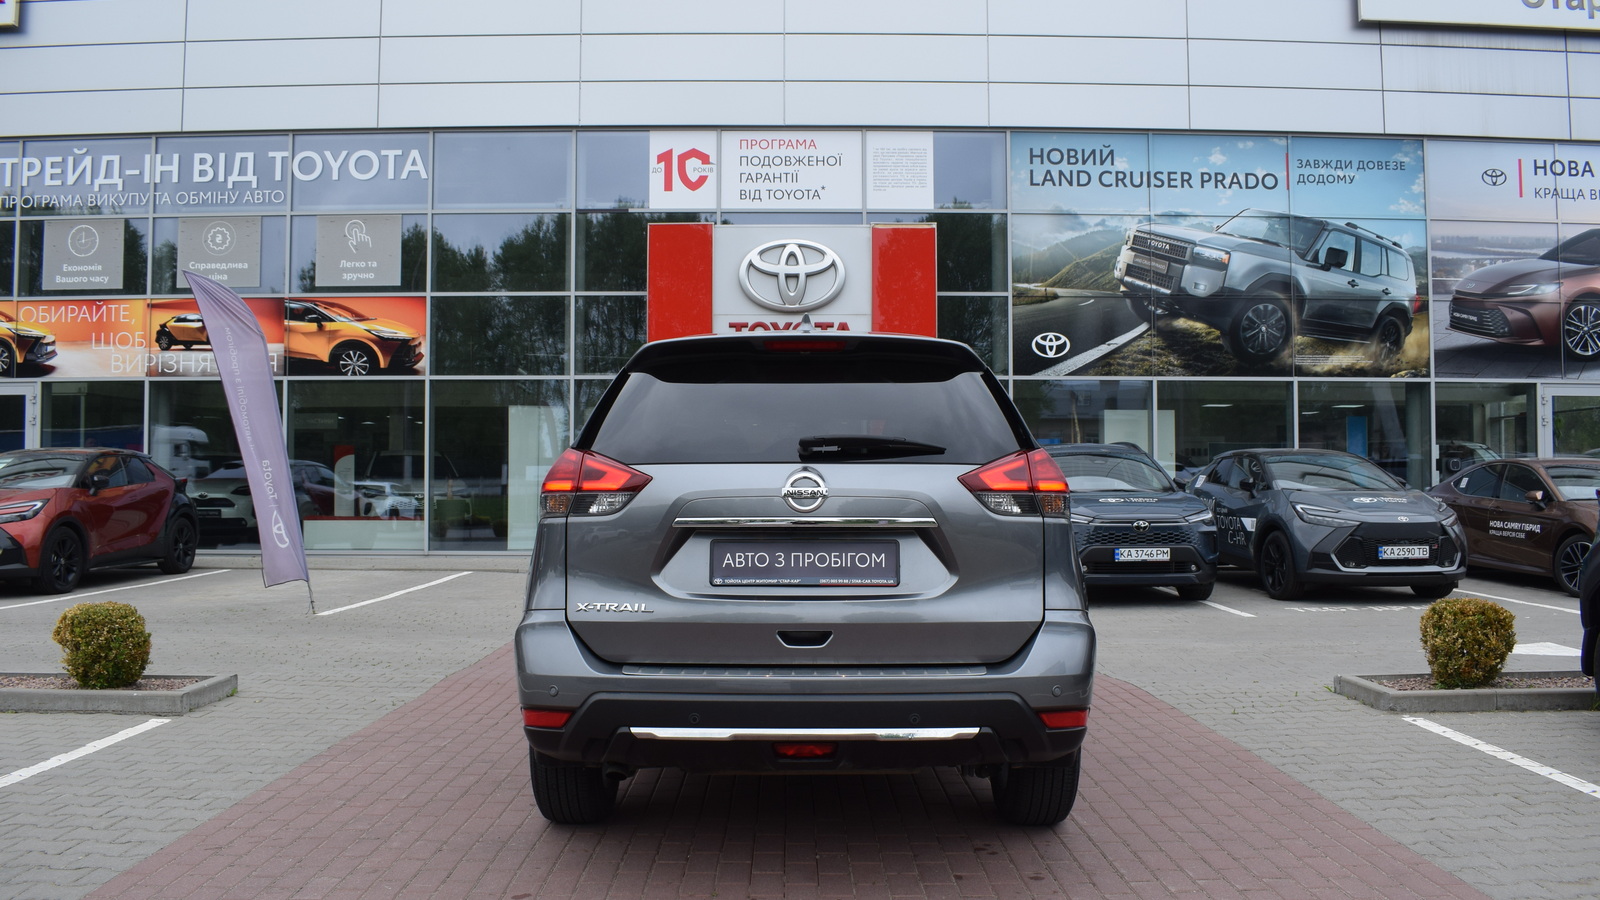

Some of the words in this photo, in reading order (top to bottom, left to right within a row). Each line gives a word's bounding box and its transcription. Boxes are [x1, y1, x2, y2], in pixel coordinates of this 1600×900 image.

[739, 138, 817, 150] ПРОГРАМА
[739, 153, 842, 168] ПОДОВЖЕНОЇ
[1029, 144, 1115, 166] НОВИЙ
[0, 147, 180, 192] ТРЕЙД-ІН
[193, 151, 258, 189] ВІД
[268, 149, 429, 181] TOYOTA
[692, 166, 714, 174] РОКІВ
[1296, 158, 1353, 171] ЗАВЖДИ
[1356, 159, 1406, 171] ДОВЕЗЕ
[1533, 159, 1595, 178] НОВА
[739, 169, 799, 183] ГАРАНТІЇ
[1029, 169, 1092, 187] LAND
[1098, 170, 1194, 189] CRUISER
[1200, 171, 1279, 190] PRADO
[1296, 173, 1356, 186] ДОДОМУ
[0, 194, 83, 209] ПРОГРАМА
[88, 192, 150, 208] ВИКУПУ
[154, 192, 171, 206] ТА
[176, 190, 239, 206] ОБМІНУ
[242, 189, 285, 204] АВТО
[739, 188, 762, 202] ВІД
[1534, 187, 1586, 202] КРАЩА
[1147, 239, 1170, 250] TOYOTA
[62, 263, 103, 272] Економія
[189, 261, 249, 271] Справедлива
[339, 260, 366, 268] Легко
[55, 275, 87, 284] Вашого
[89, 275, 109, 284] часу
[342, 272, 375, 281] зручно
[19, 301, 136, 325] ОБИРАЙТЕ,
[91, 331, 146, 352] ЩОБ
[1216, 515, 1242, 530] TOYOTA
[1489, 520, 1503, 528] НОВА
[1504, 521, 1521, 530] CAMRY
[1227, 531, 1247, 546] C-HR
[1120, 549, 1133, 558] KA
[1134, 549, 1155, 558] 3746
[1156, 549, 1169, 558] PM
[1384, 547, 1395, 556] KA
[1396, 547, 1416, 556] 2590
[1417, 547, 1428, 556] TB
[722, 552, 770, 568] АВТО
[791, 552, 886, 568] ПРОБІГОМ
[575, 602, 654, 613] X-TRAIL
